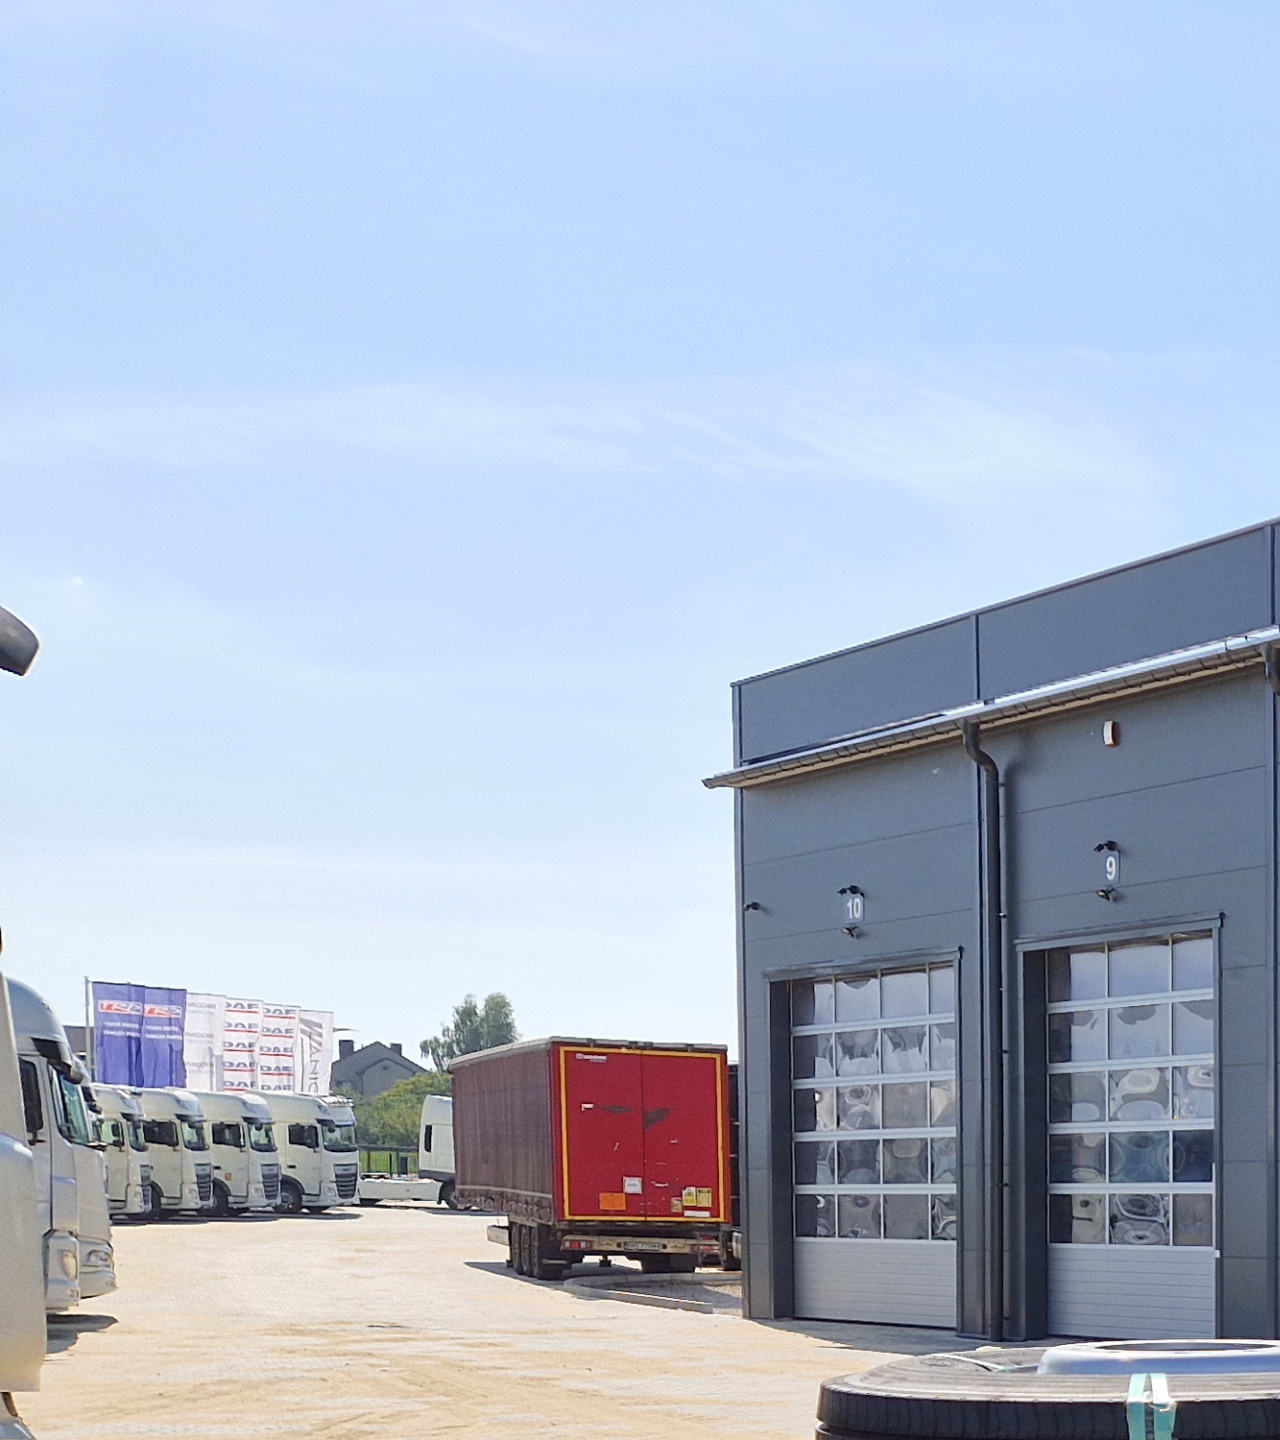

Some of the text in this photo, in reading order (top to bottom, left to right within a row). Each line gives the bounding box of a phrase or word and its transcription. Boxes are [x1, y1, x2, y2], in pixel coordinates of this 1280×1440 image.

[1105, 855, 1116, 881] 9
[846, 897, 861, 920] 10
[261, 1026, 295, 1035] DAF
[223, 1041, 256, 1049] DAF
[260, 1046, 294, 1054] DAF
[222, 1061, 255, 1069] DAF
[260, 1065, 293, 1073] DAF
[261, 1084, 293, 1092] DAF
